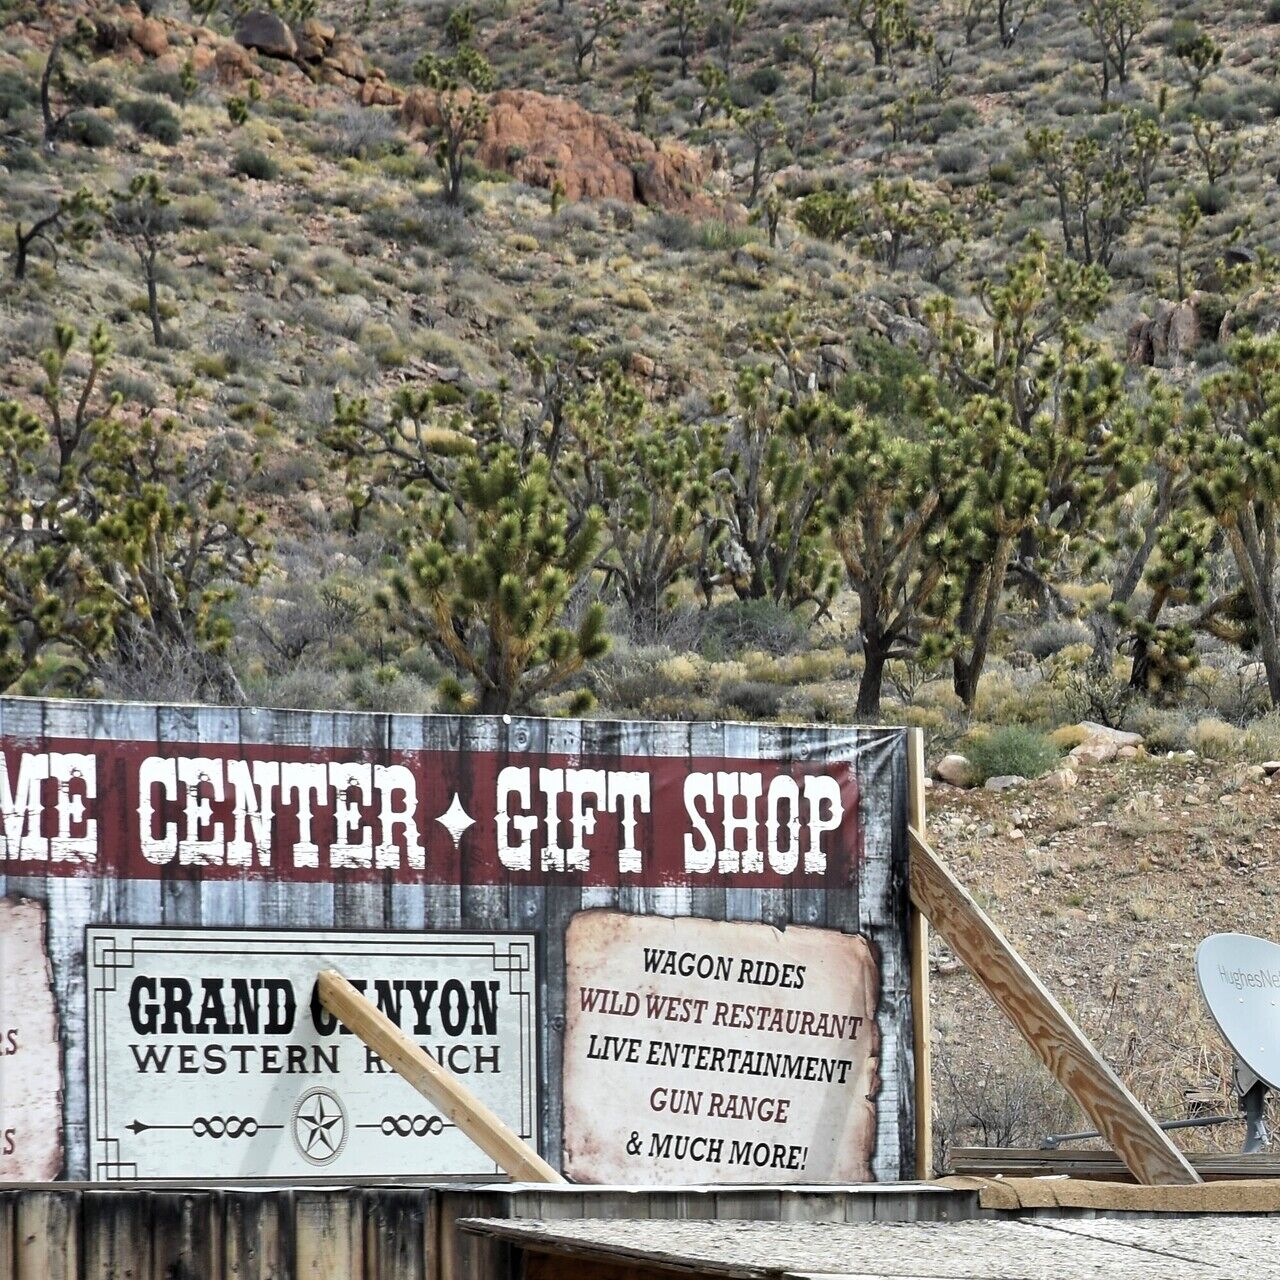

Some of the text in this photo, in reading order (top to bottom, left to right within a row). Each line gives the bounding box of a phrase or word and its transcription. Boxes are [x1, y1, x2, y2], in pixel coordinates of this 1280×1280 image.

[0, 751, 845, 876] ME CENTER GIFT SHOP
[643, 948, 807, 989] WAGON RIDES
[128, 975, 297, 1035] GRAND
[579, 986, 863, 1040] WILD WEST RESTAURANT
[128, 1044, 500, 1075] WESTERN RNCH
[587, 1034, 852, 1084] LIVE ENTERTAINMENT
[650, 1087, 790, 1124] GUN RANGE
[626, 1131, 808, 1170] & MUCH MORE!
